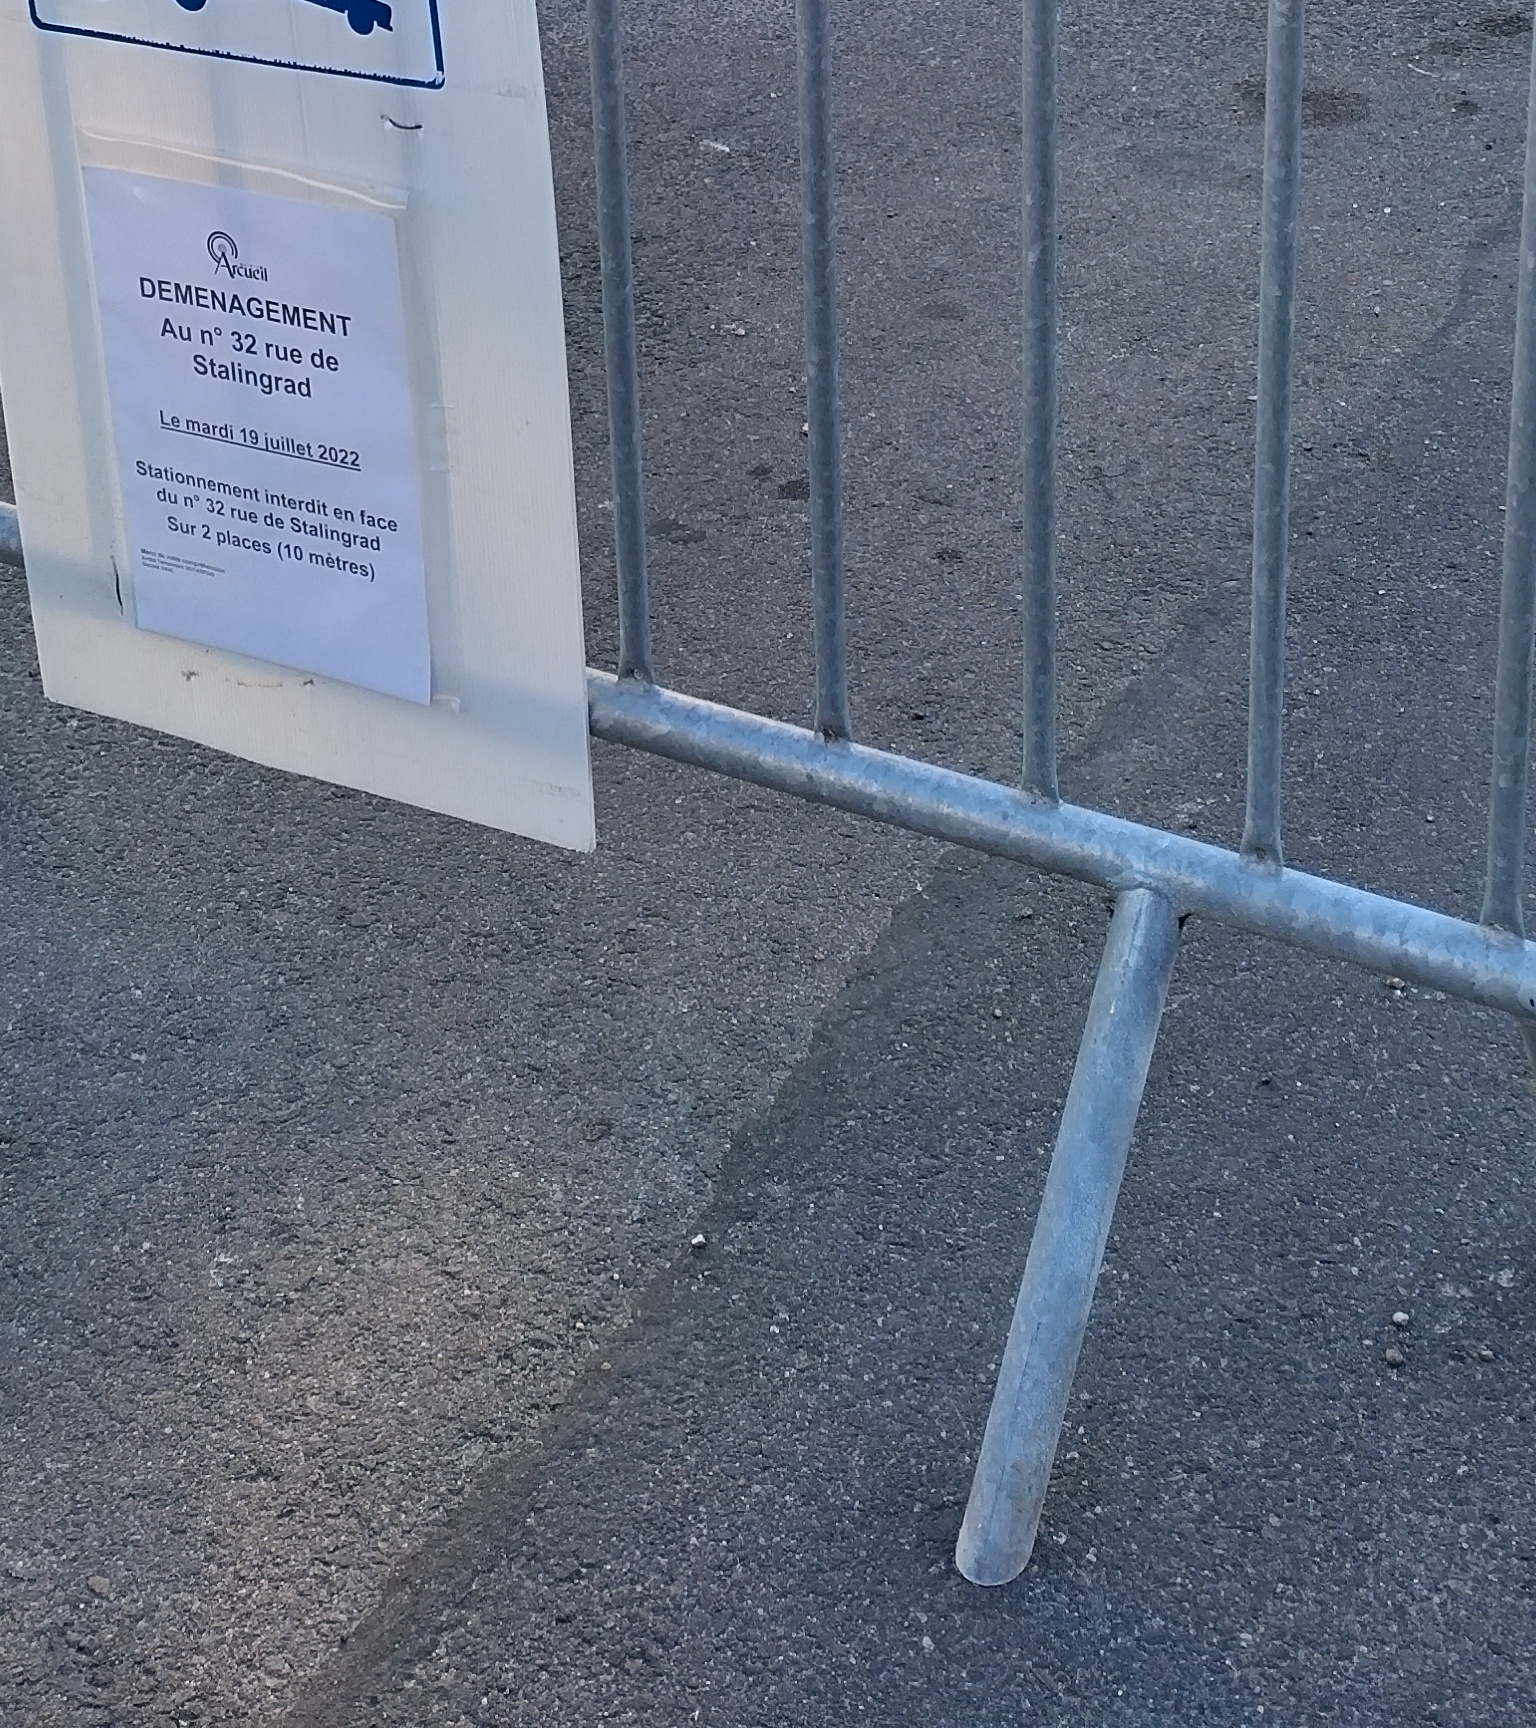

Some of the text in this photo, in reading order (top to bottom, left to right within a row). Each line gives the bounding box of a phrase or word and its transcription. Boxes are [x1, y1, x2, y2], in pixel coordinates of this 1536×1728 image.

[214, 251, 268, 282] Arcueil
[139, 276, 351, 337] DEMENAGEMENT
[161, 318, 339, 372] Au n° 32 rue de
[193, 354, 312, 398] Stalingrad
[159, 410, 361, 467] Le mardi 19 juillet 2022
[135, 460, 398, 532] Stationnement interdit en face
[156, 488, 381, 552] du n° 32 rue de Stalingrad
[167, 515, 375, 582] Sur 2 places (10 mètres)
